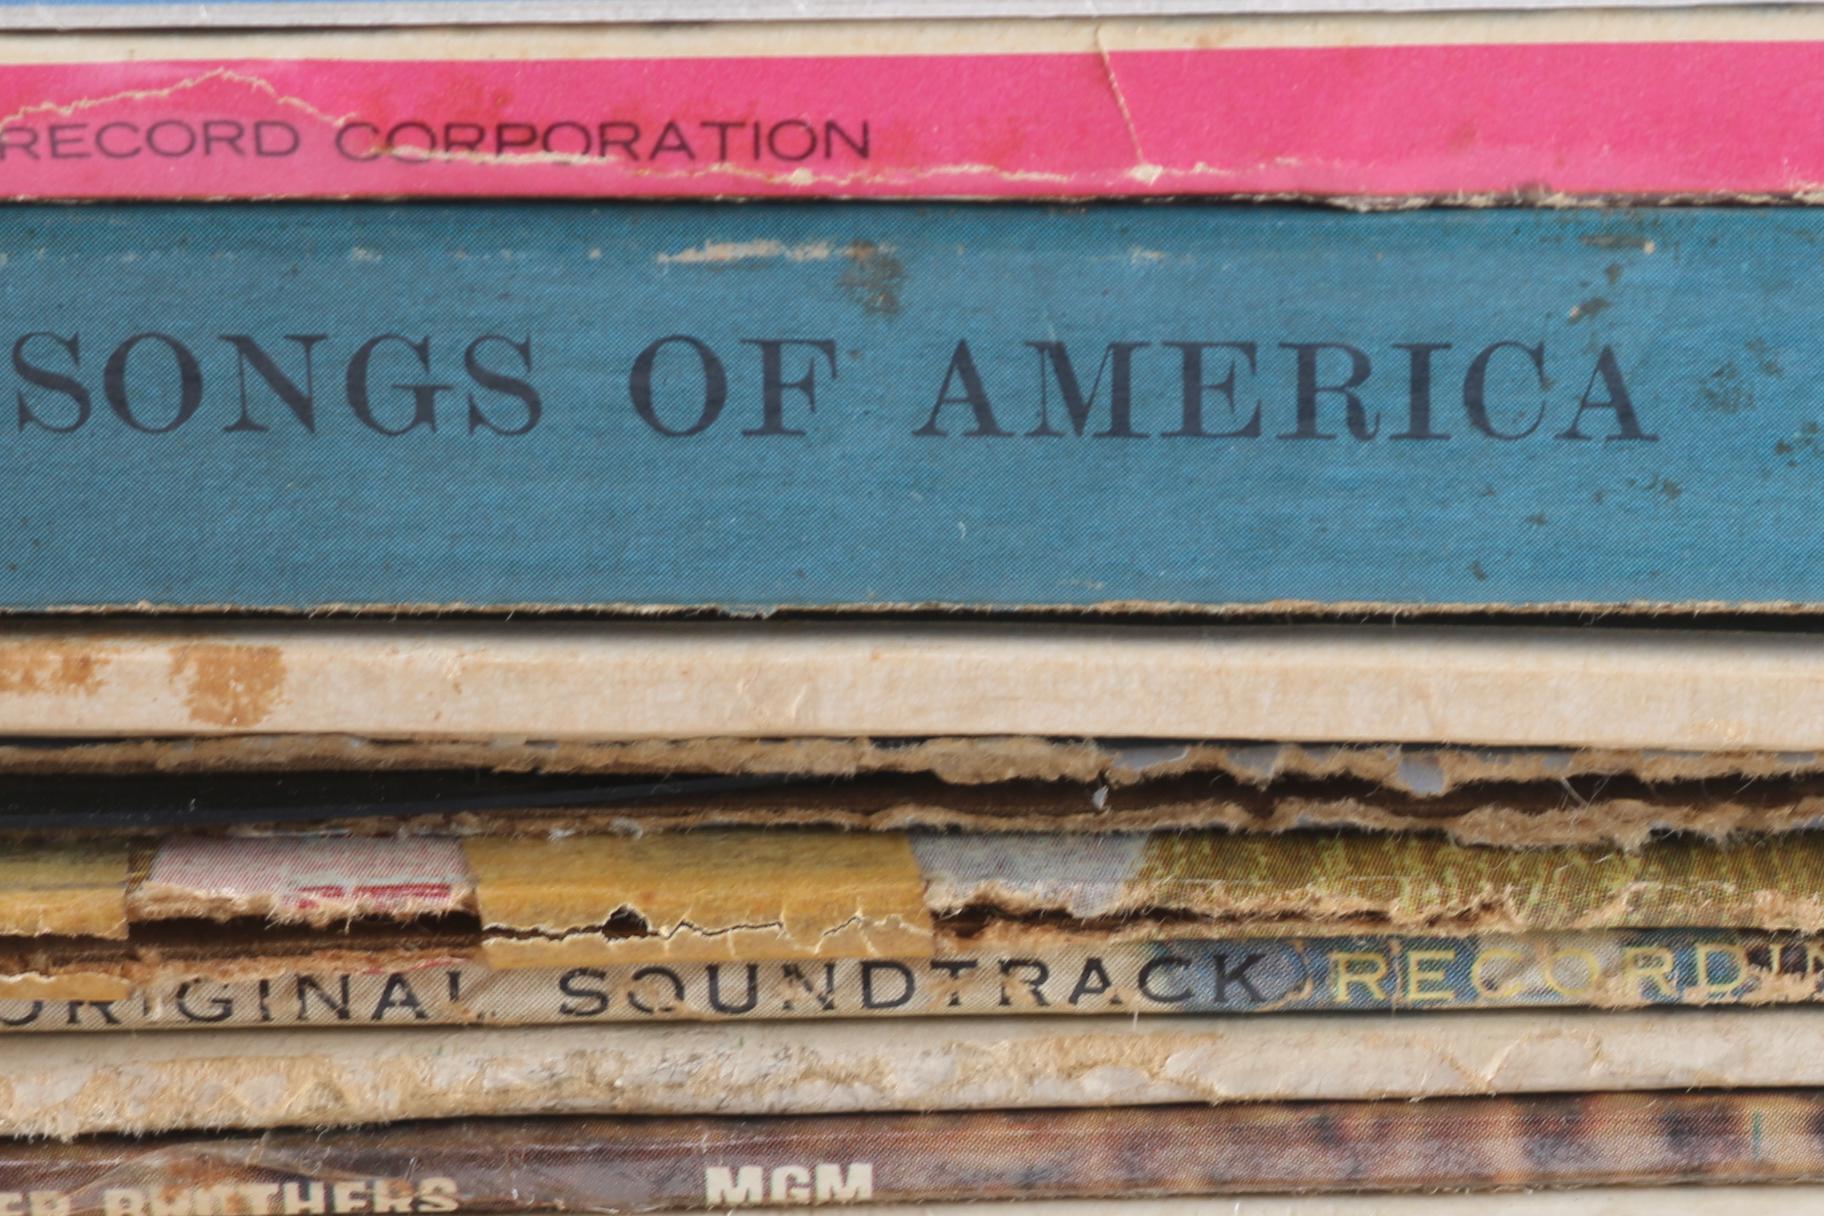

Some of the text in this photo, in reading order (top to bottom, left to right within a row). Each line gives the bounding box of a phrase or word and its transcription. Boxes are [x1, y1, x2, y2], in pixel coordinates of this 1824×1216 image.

[0, 118, 871, 165] RECORD CORPORATION
[11, 331, 1660, 442] SONGS OF AMERICA
[558, 950, 1267, 1017] SOUNDTRACK
[705, 1162, 873, 1206] MGM
